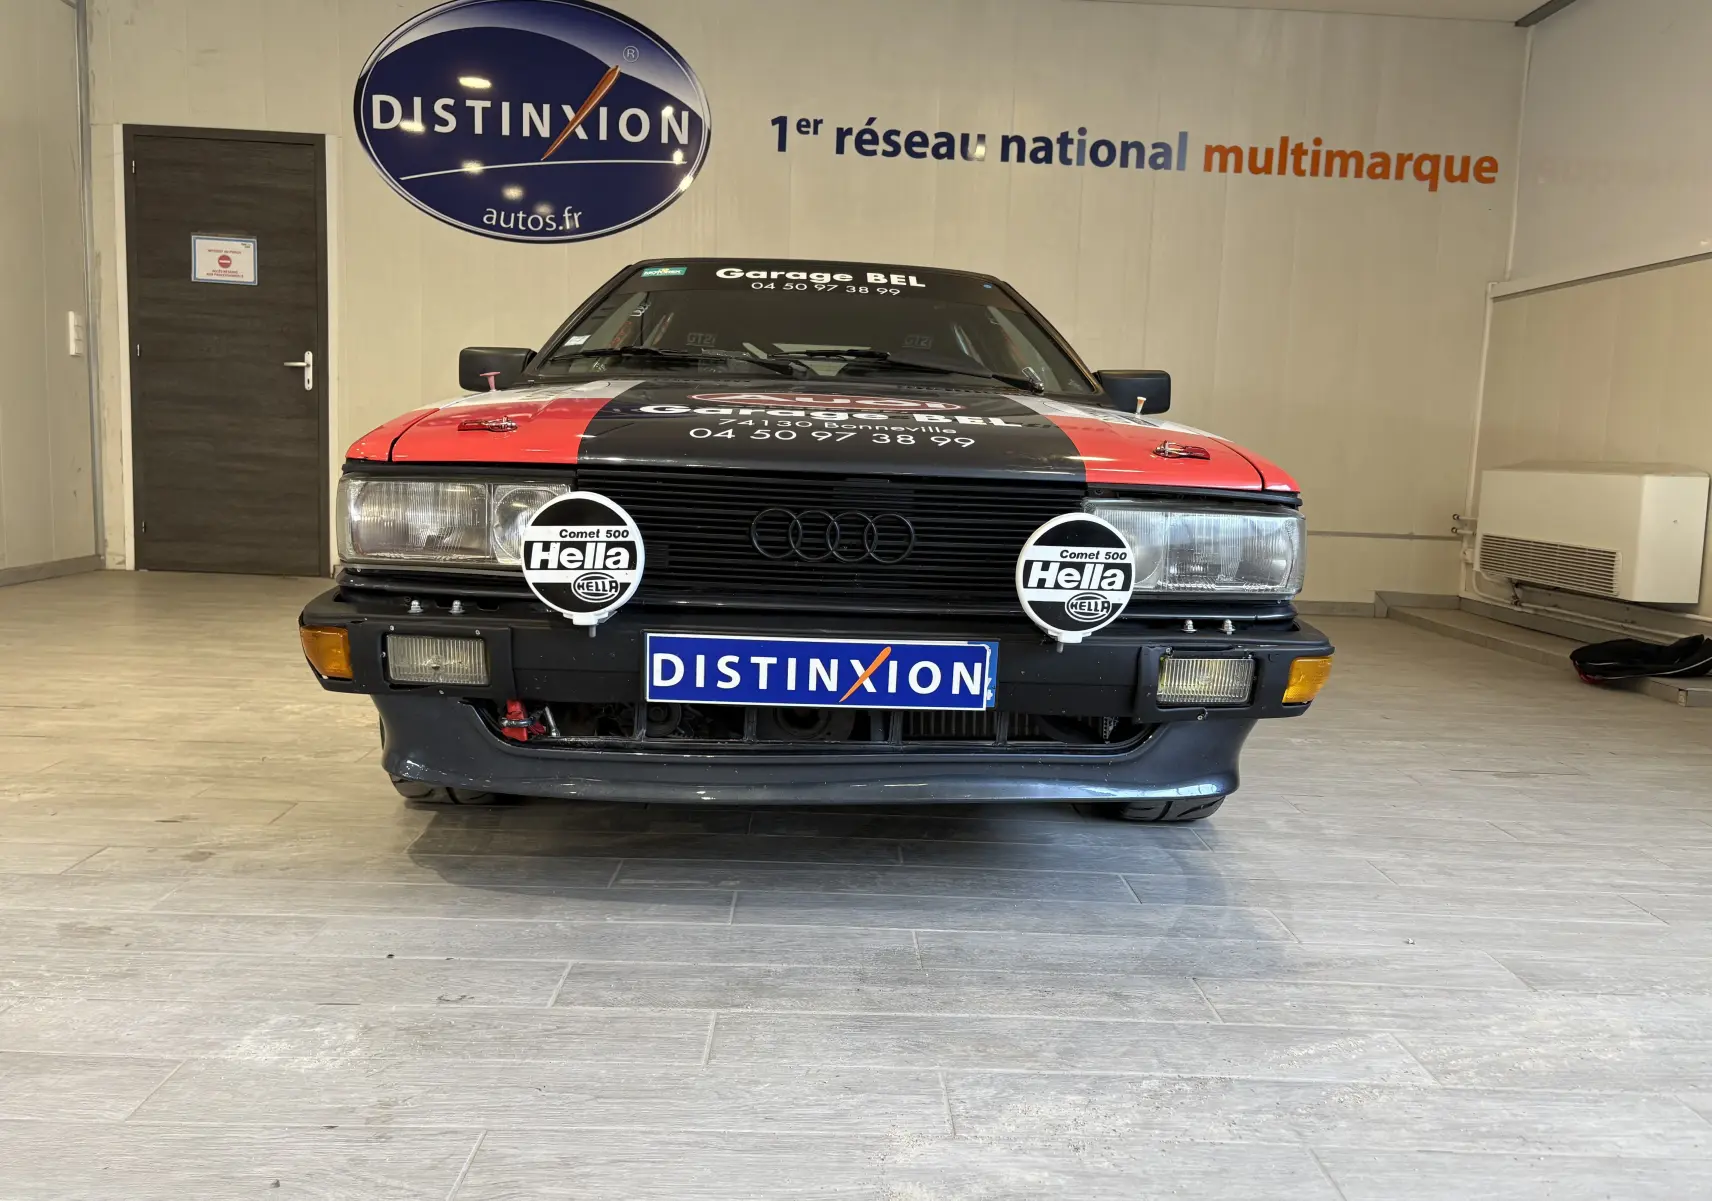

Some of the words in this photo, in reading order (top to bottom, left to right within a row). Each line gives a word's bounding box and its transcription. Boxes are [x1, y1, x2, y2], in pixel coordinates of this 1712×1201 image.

[372, 66, 689, 160] DISTINXION
[835, 117, 987, 162] réseau
[1000, 126, 1188, 171] national
[1203, 136, 1499, 192] multimarque
[482, 206, 583, 232] autos.fr
[715, 268, 853, 284] Garage
[866, 272, 926, 288] BEL
[751, 282, 776, 290] 04
[782, 283, 808, 291] 50
[814, 284, 838, 292] 97
[846, 285, 869, 294] 38
[876, 287, 900, 296] 99
[639, 404, 889, 420] Garage
[912, 413, 1022, 427] BEL
[718, 418, 812, 428] 74130
[824, 421, 957, 434] Bonneville
[689, 427, 735, 439] 04
[750, 429, 797, 441] 50
[811, 430, 857, 442] 97
[872, 433, 916, 445] 38
[930, 435, 975, 448] 99
[559, 528, 600, 538] Comet
[605, 529, 629, 539] 500
[530, 542, 630, 569] Hella
[1060, 549, 1100, 560] Comet
[1104, 551, 1127, 561] 500
[577, 580, 619, 592] HELLA
[1027, 561, 1125, 590] Hella
[1070, 600, 1111, 614] HELLA
[653, 646, 982, 703] DISTINXION
